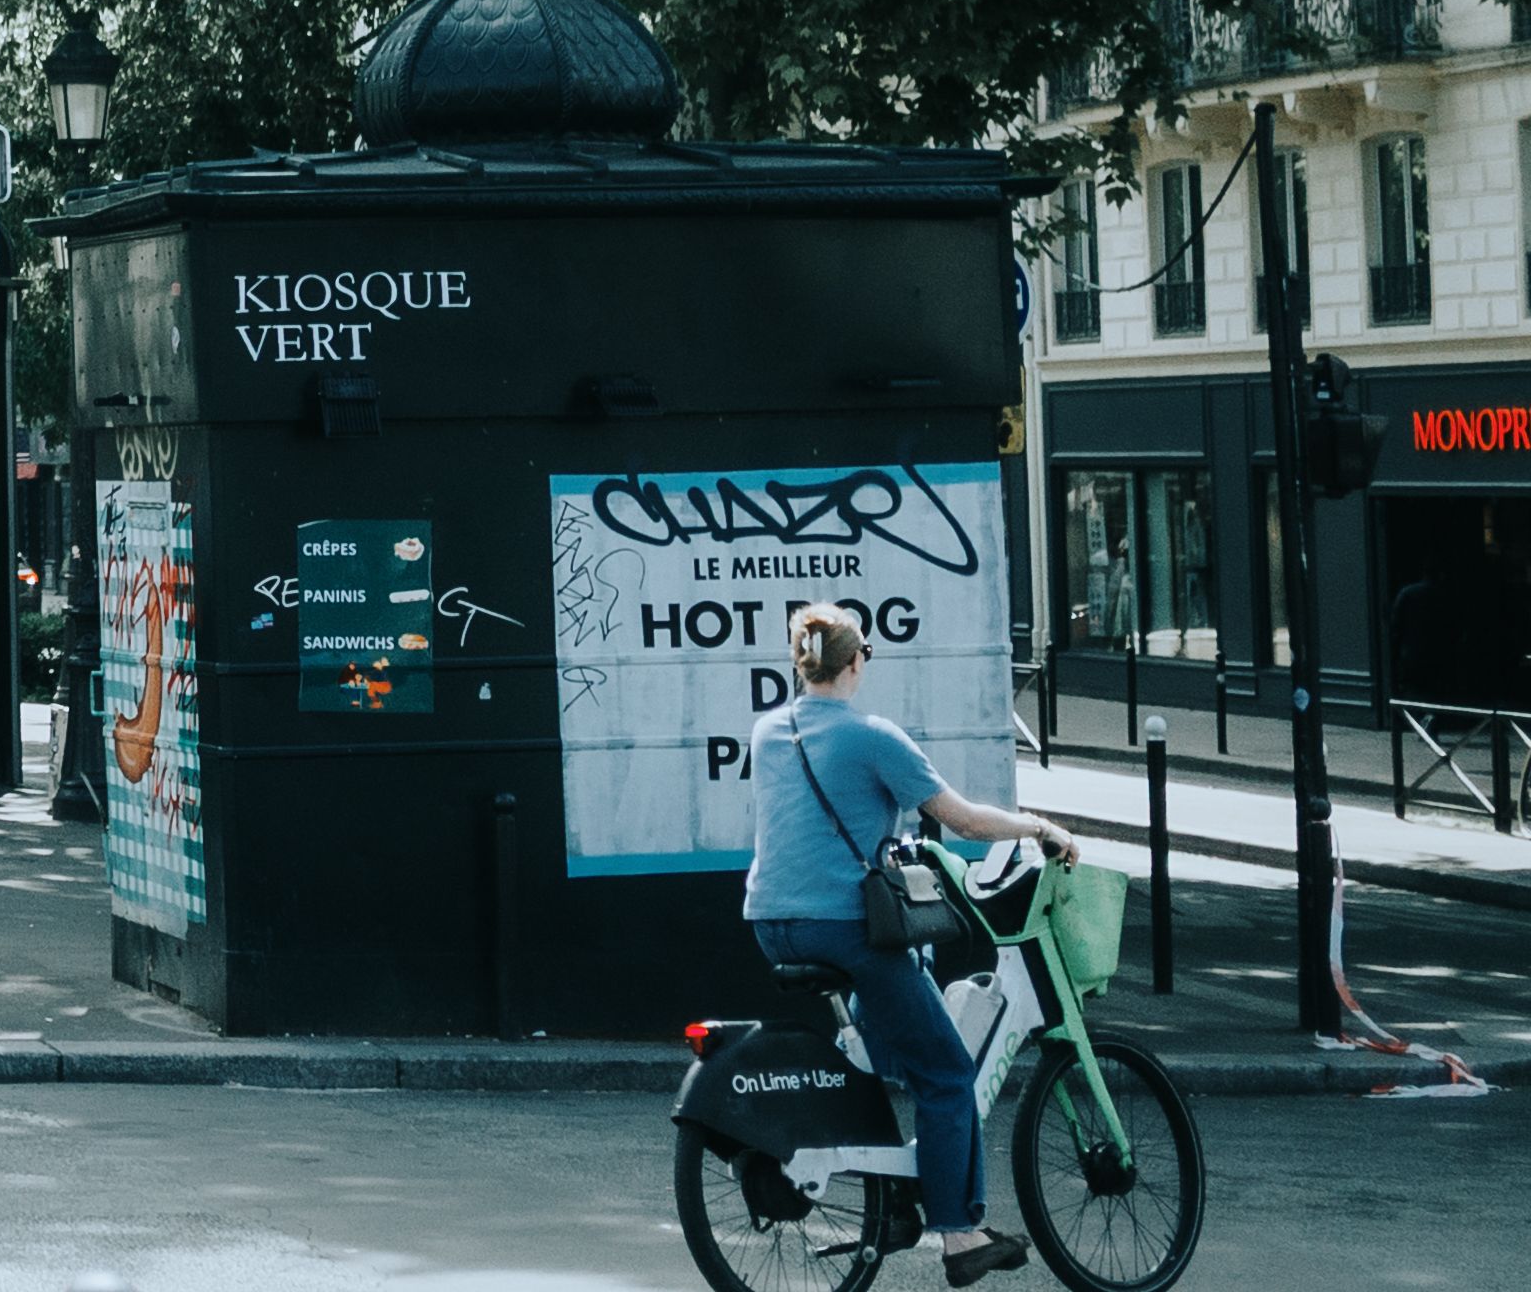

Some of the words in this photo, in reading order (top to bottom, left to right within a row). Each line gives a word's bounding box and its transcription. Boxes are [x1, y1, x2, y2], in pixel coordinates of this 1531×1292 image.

[234, 271, 471, 320] KIOSQUE
[235, 322, 372, 362] VERT
[1413, 407, 1531, 452] MONOPR
[302, 539, 357, 557] CRÊPES
[693, 557, 721, 581] LE
[731, 554, 863, 580] MEILLEUR
[303, 589, 367, 603] PANINIS
[641, 600, 764, 649] HOT
[303, 636, 395, 651] SANDWICHS
[732, 1074, 759, 1094] On
[760, 1072, 800, 1092] Lime
[812, 1070, 846, 1088] Uber
